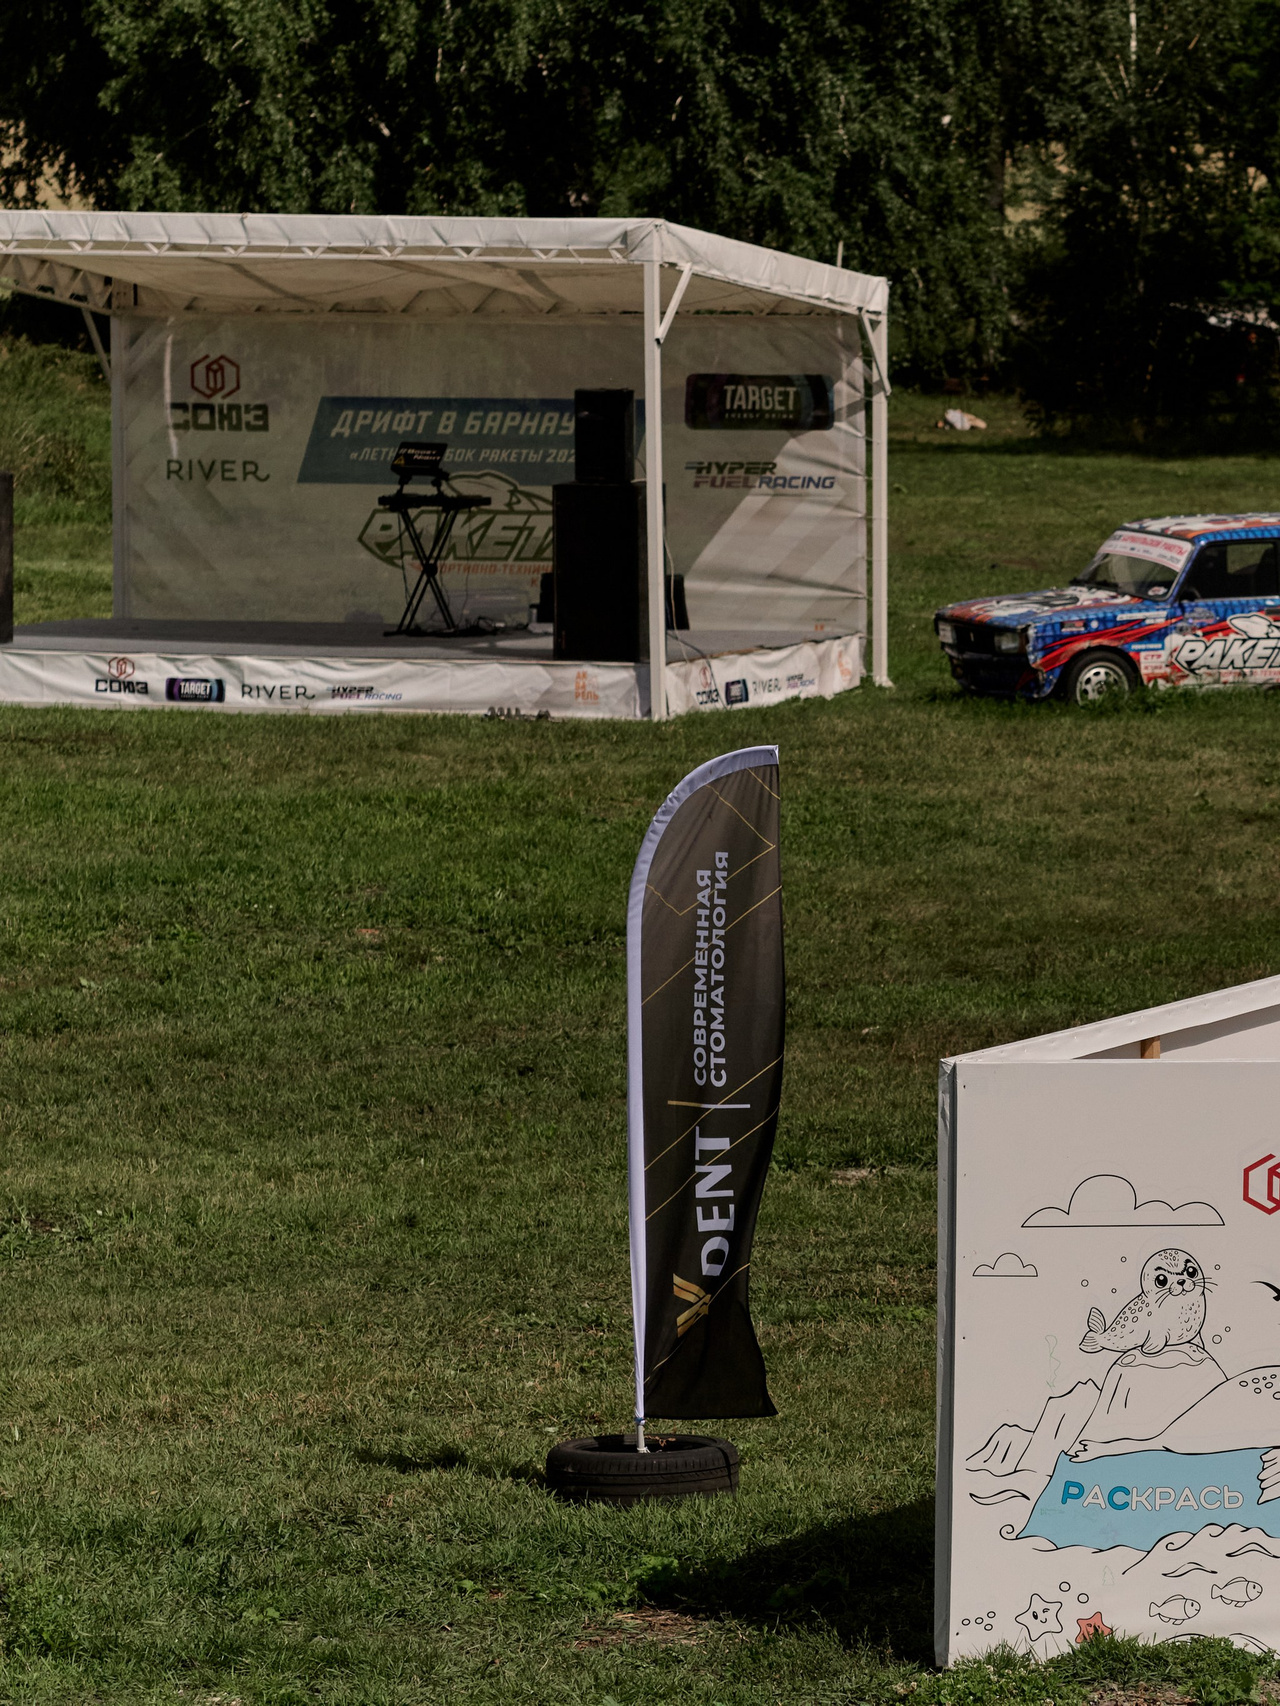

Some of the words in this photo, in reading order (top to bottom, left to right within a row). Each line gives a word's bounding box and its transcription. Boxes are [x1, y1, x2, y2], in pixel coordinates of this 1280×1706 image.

[724, 384, 798, 411] TARGET
[168, 403, 269, 431] СОЮЗ
[330, 409, 433, 438] ДРИФТ
[436, 410, 457, 435] В
[462, 410, 576, 436] БАРНАУ
[350, 447, 399, 462] «ЛЕТН
[443, 448, 477, 462] БОК
[478, 448, 544, 463] РАКЕТЫ
[545, 448, 576, 463] 202
[690, 461, 777, 475] HYPER
[166, 459, 270, 482] RIVER
[358, 509, 554, 561] РАКЕТ
[95, 679, 149, 695] СОЮЗ
[180, 681, 211, 695] TARGET
[241, 683, 316, 700] RIVER
[693, 869, 712, 1087] СОВРЕМЕННАЯ
[709, 851, 729, 1088] СТОМАТОЛОГИЯ
[1061, 1480, 1245, 1512] РАСКРАСЬ
